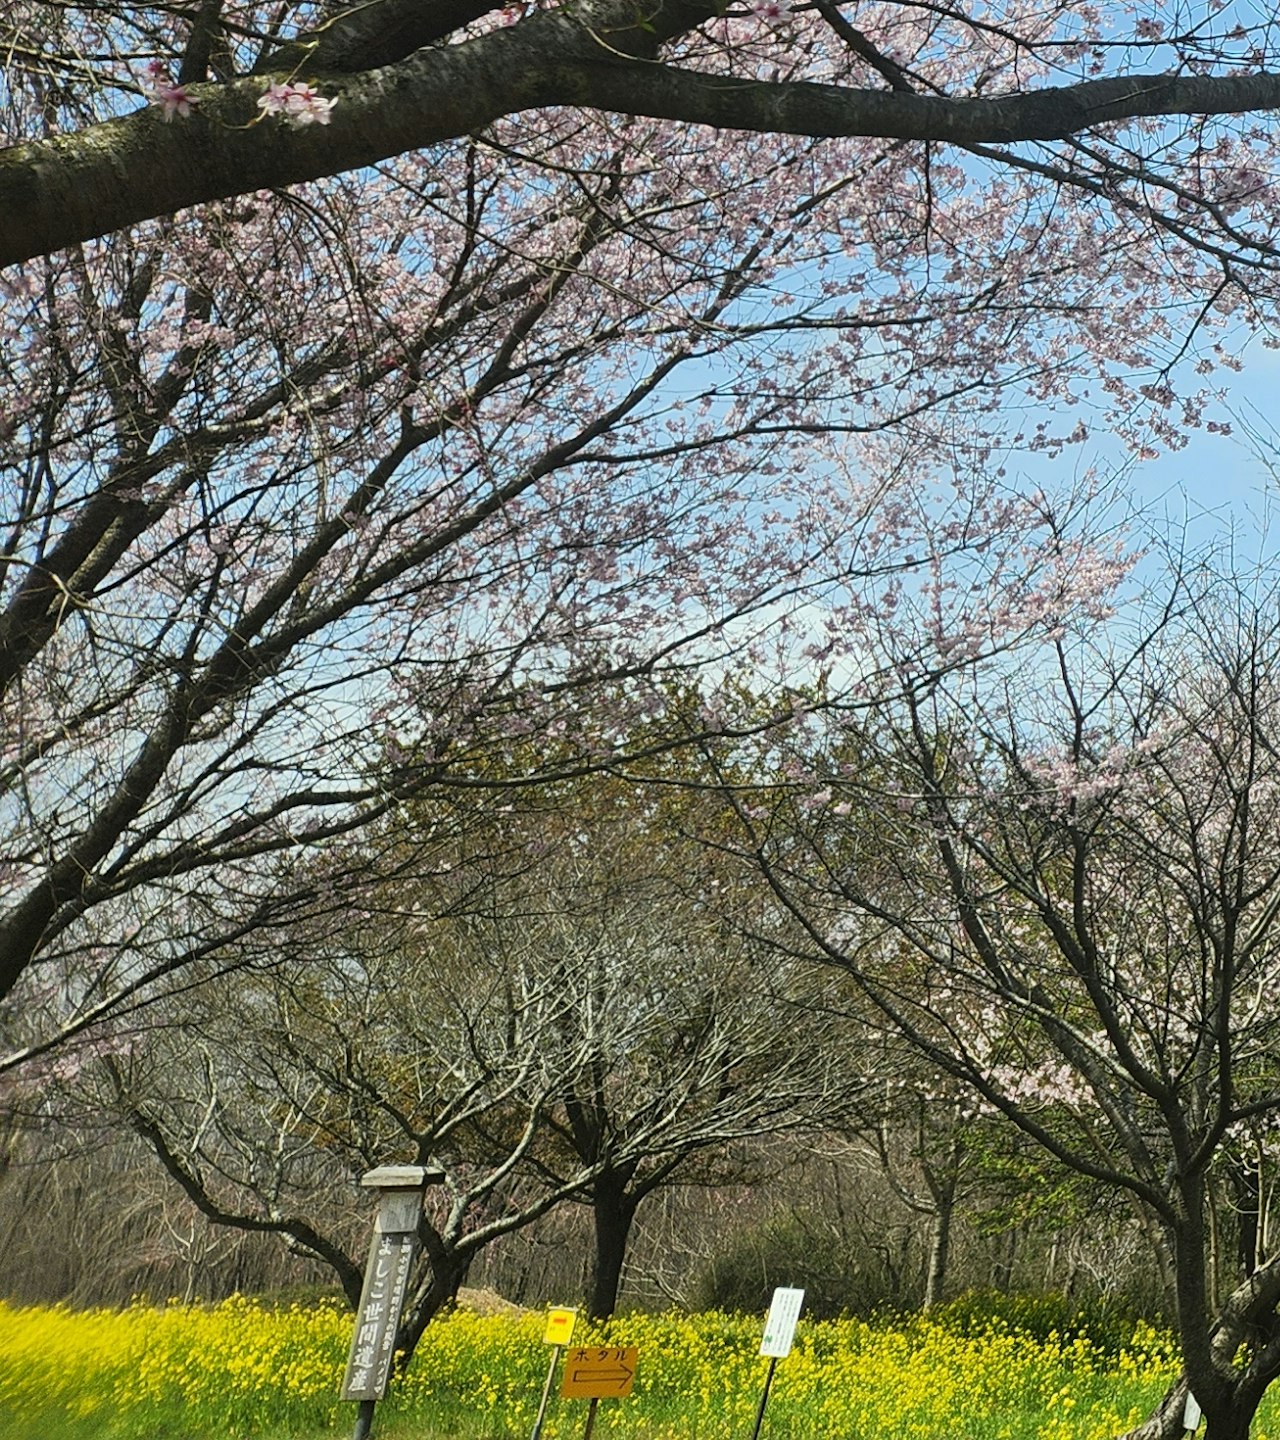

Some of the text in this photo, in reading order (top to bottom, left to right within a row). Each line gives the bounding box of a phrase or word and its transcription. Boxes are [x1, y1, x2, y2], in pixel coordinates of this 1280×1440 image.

[347, 1236, 392, 1393] ましこ世間遺産
[573, 1349, 627, 1362] ホタル
